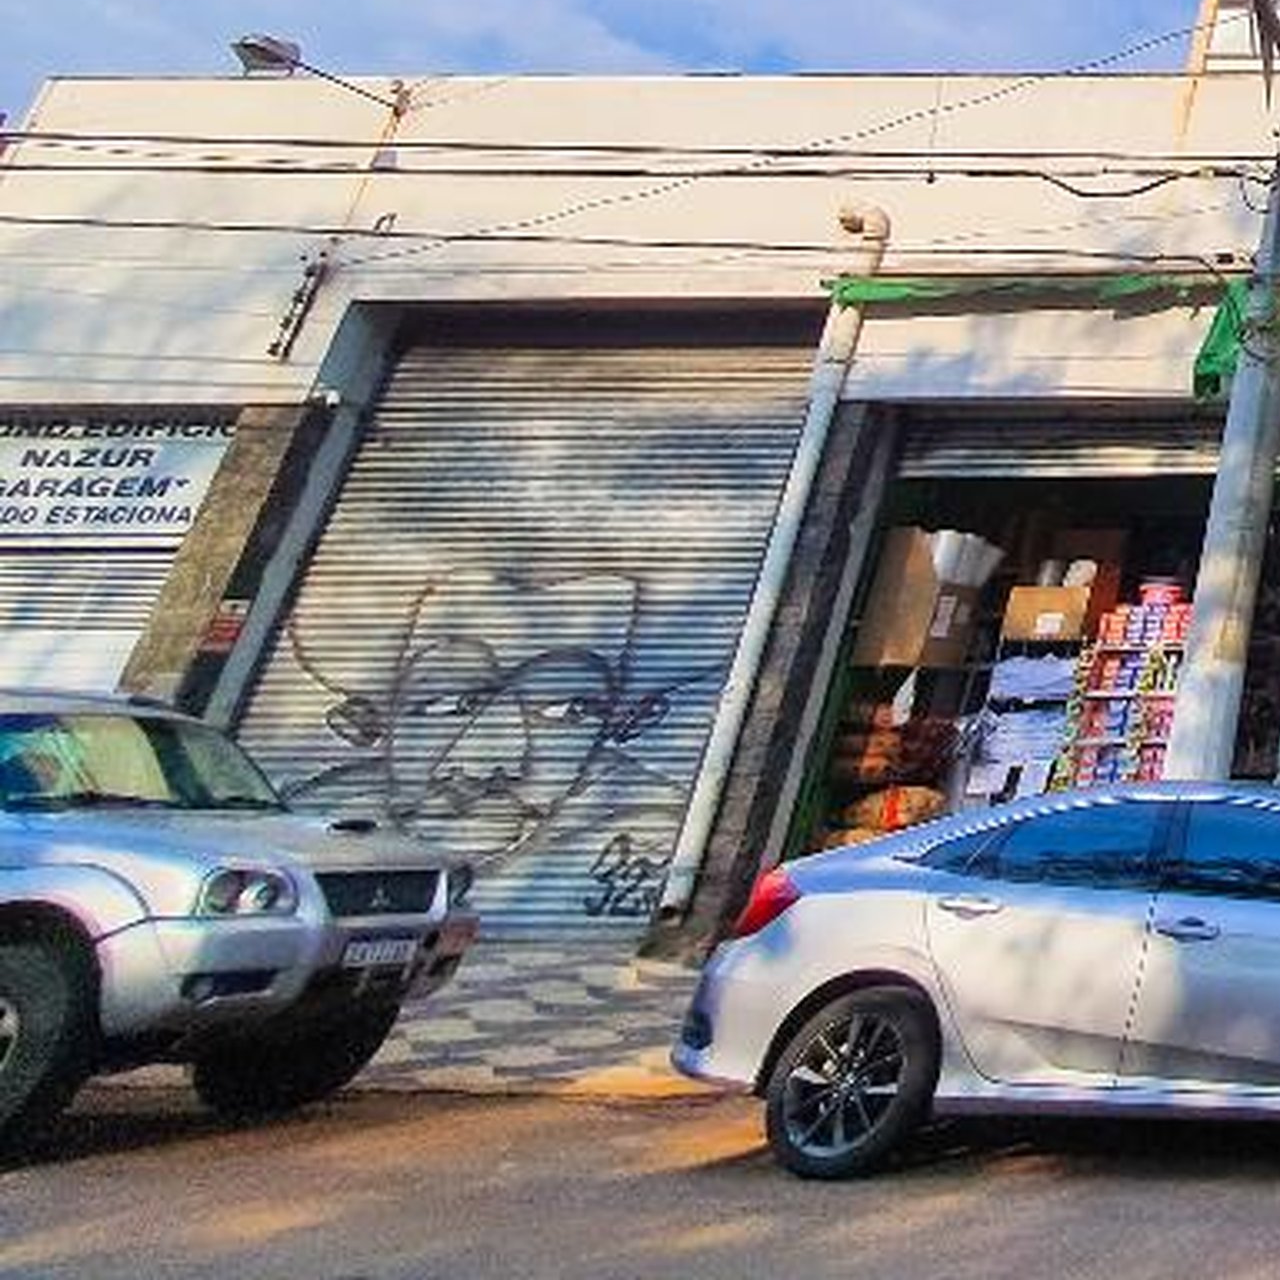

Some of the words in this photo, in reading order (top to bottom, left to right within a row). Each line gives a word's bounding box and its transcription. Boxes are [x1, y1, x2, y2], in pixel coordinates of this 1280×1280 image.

[21, 448, 156, 468] NAZUR
[0, 505, 38, 524] DO
[46, 505, 191, 524] ESTACIONA
